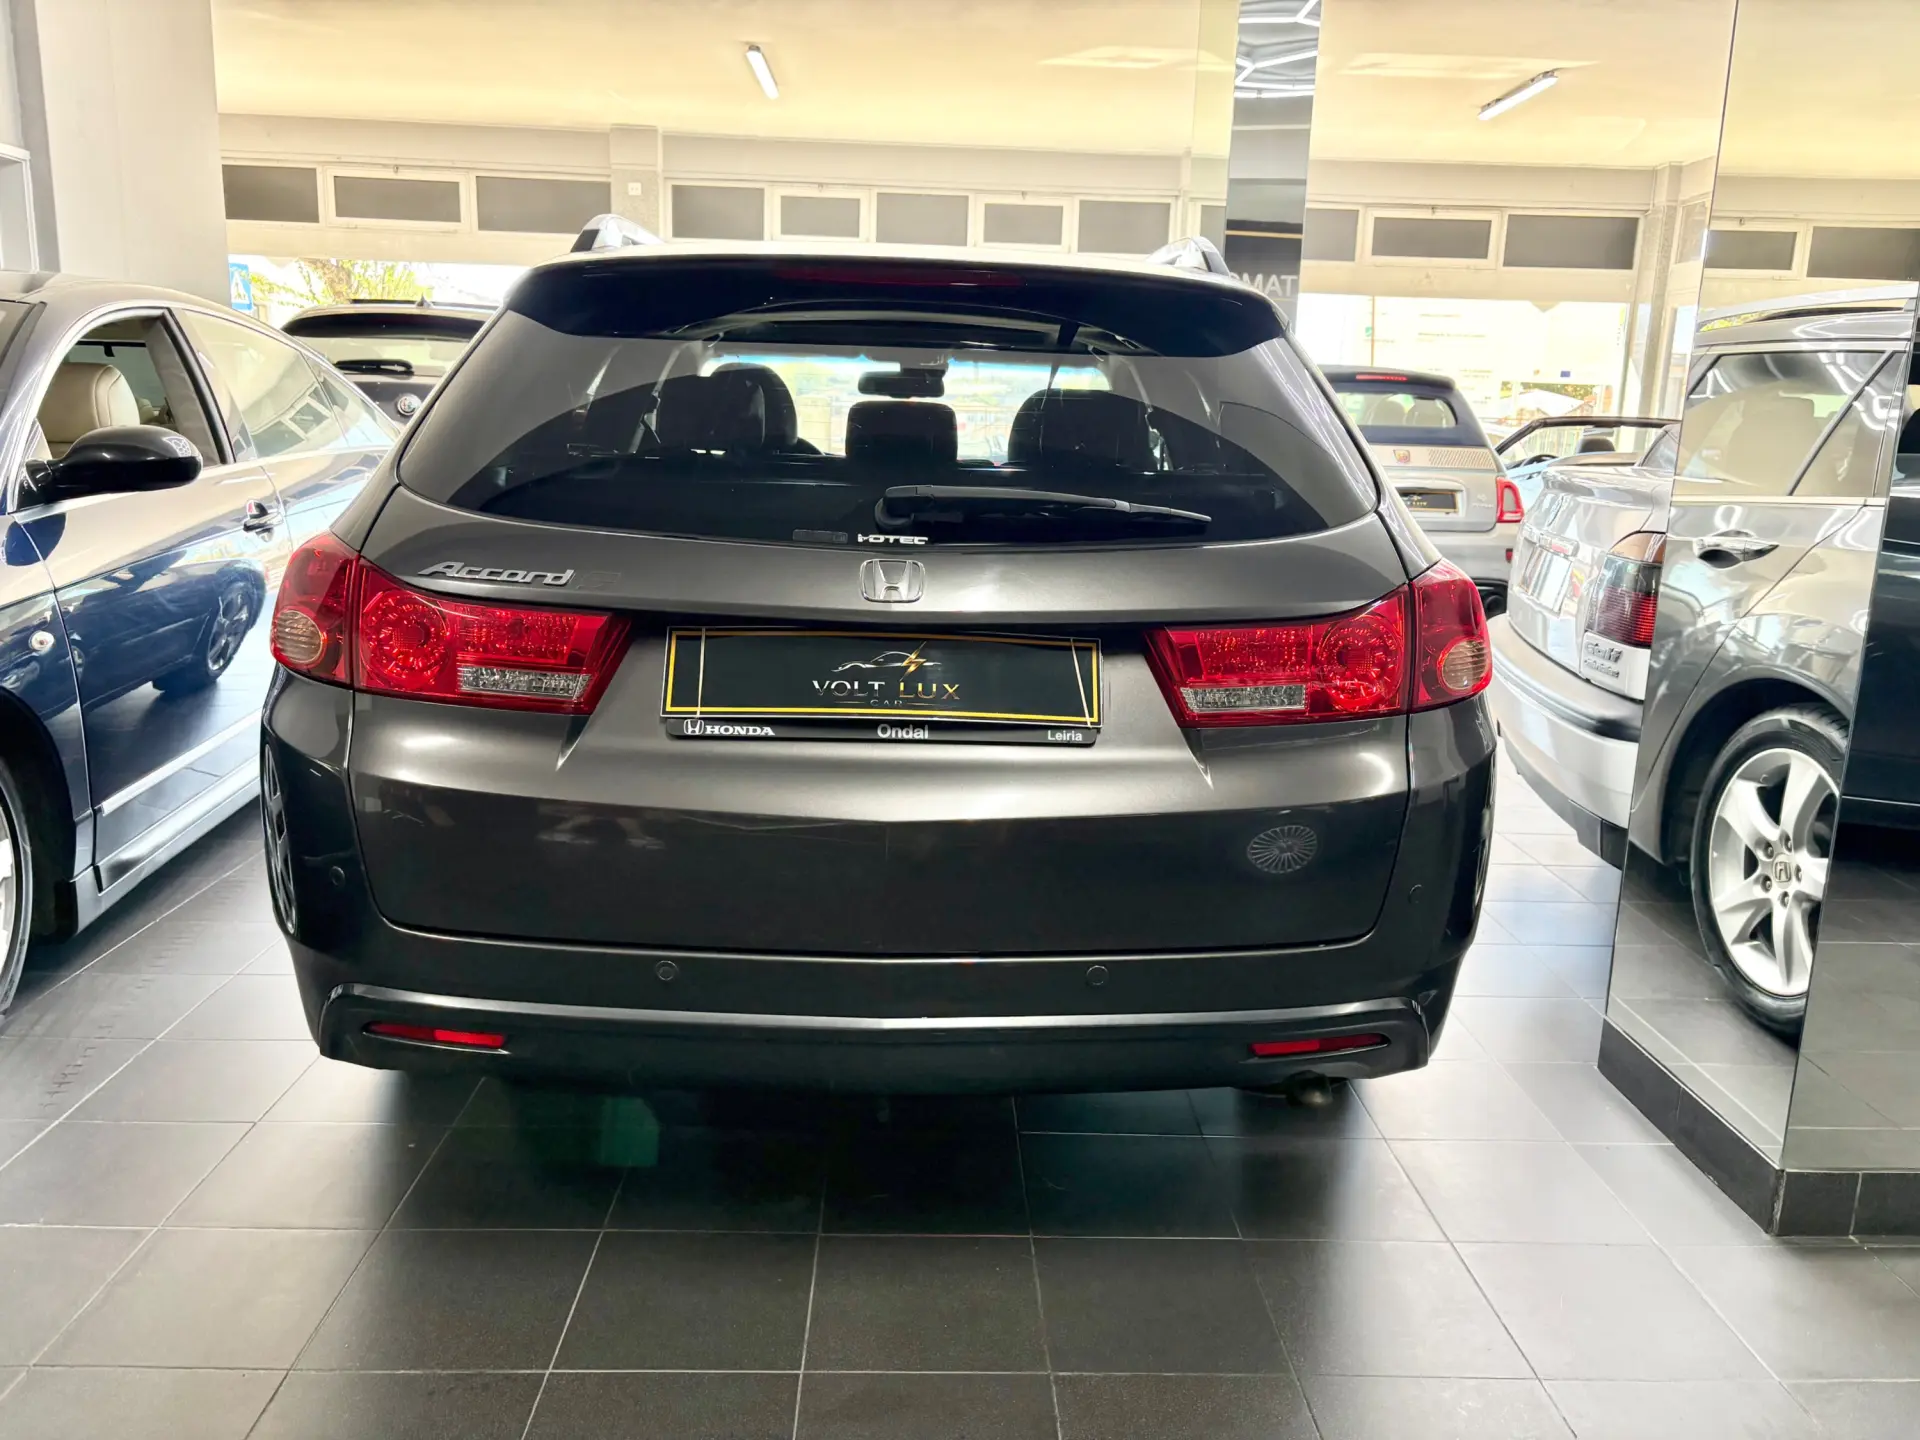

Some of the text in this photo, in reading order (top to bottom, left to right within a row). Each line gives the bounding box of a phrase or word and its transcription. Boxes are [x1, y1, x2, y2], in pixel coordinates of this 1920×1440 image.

[418, 561, 575, 586] Accord
[812, 680, 960, 700] VOLT LUX
[705, 725, 775, 736] HONDA
[877, 723, 929, 739] Ondal
[1047, 730, 1083, 742] Leiria
